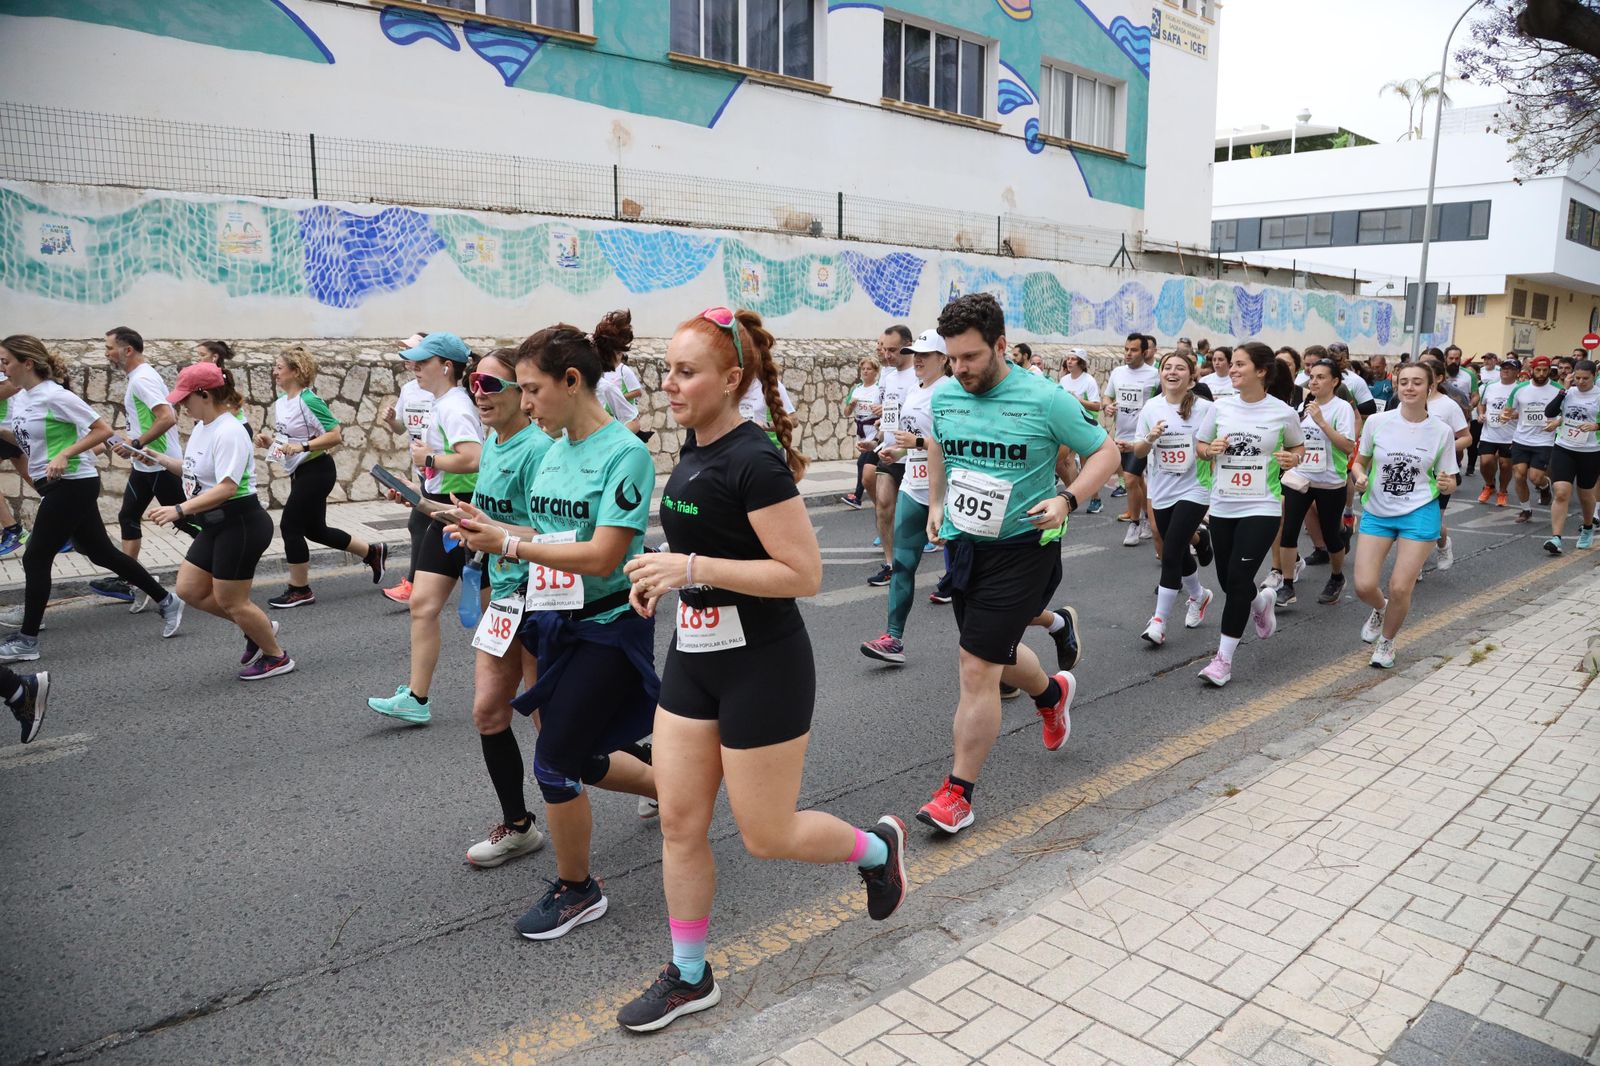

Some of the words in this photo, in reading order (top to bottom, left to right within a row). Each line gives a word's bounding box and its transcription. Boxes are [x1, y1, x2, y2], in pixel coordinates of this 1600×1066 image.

[1162, 29, 1181, 46] SAFA
[1190, 40, 1206, 55] ICET
[1121, 392, 1138, 401] 501
[1527, 413, 1544, 421] 600
[1568, 428, 1581, 438] 57
[1161, 450, 1186, 464] 339
[1231, 472, 1252, 487] 49
[677, 500, 699, 515] Trials
[954, 493, 993, 521] 495
[535, 565, 576, 591] 315
[679, 600, 720, 630] 189
[699, 640, 721, 649] POPULAR
[728, 637, 744, 645] PALO
